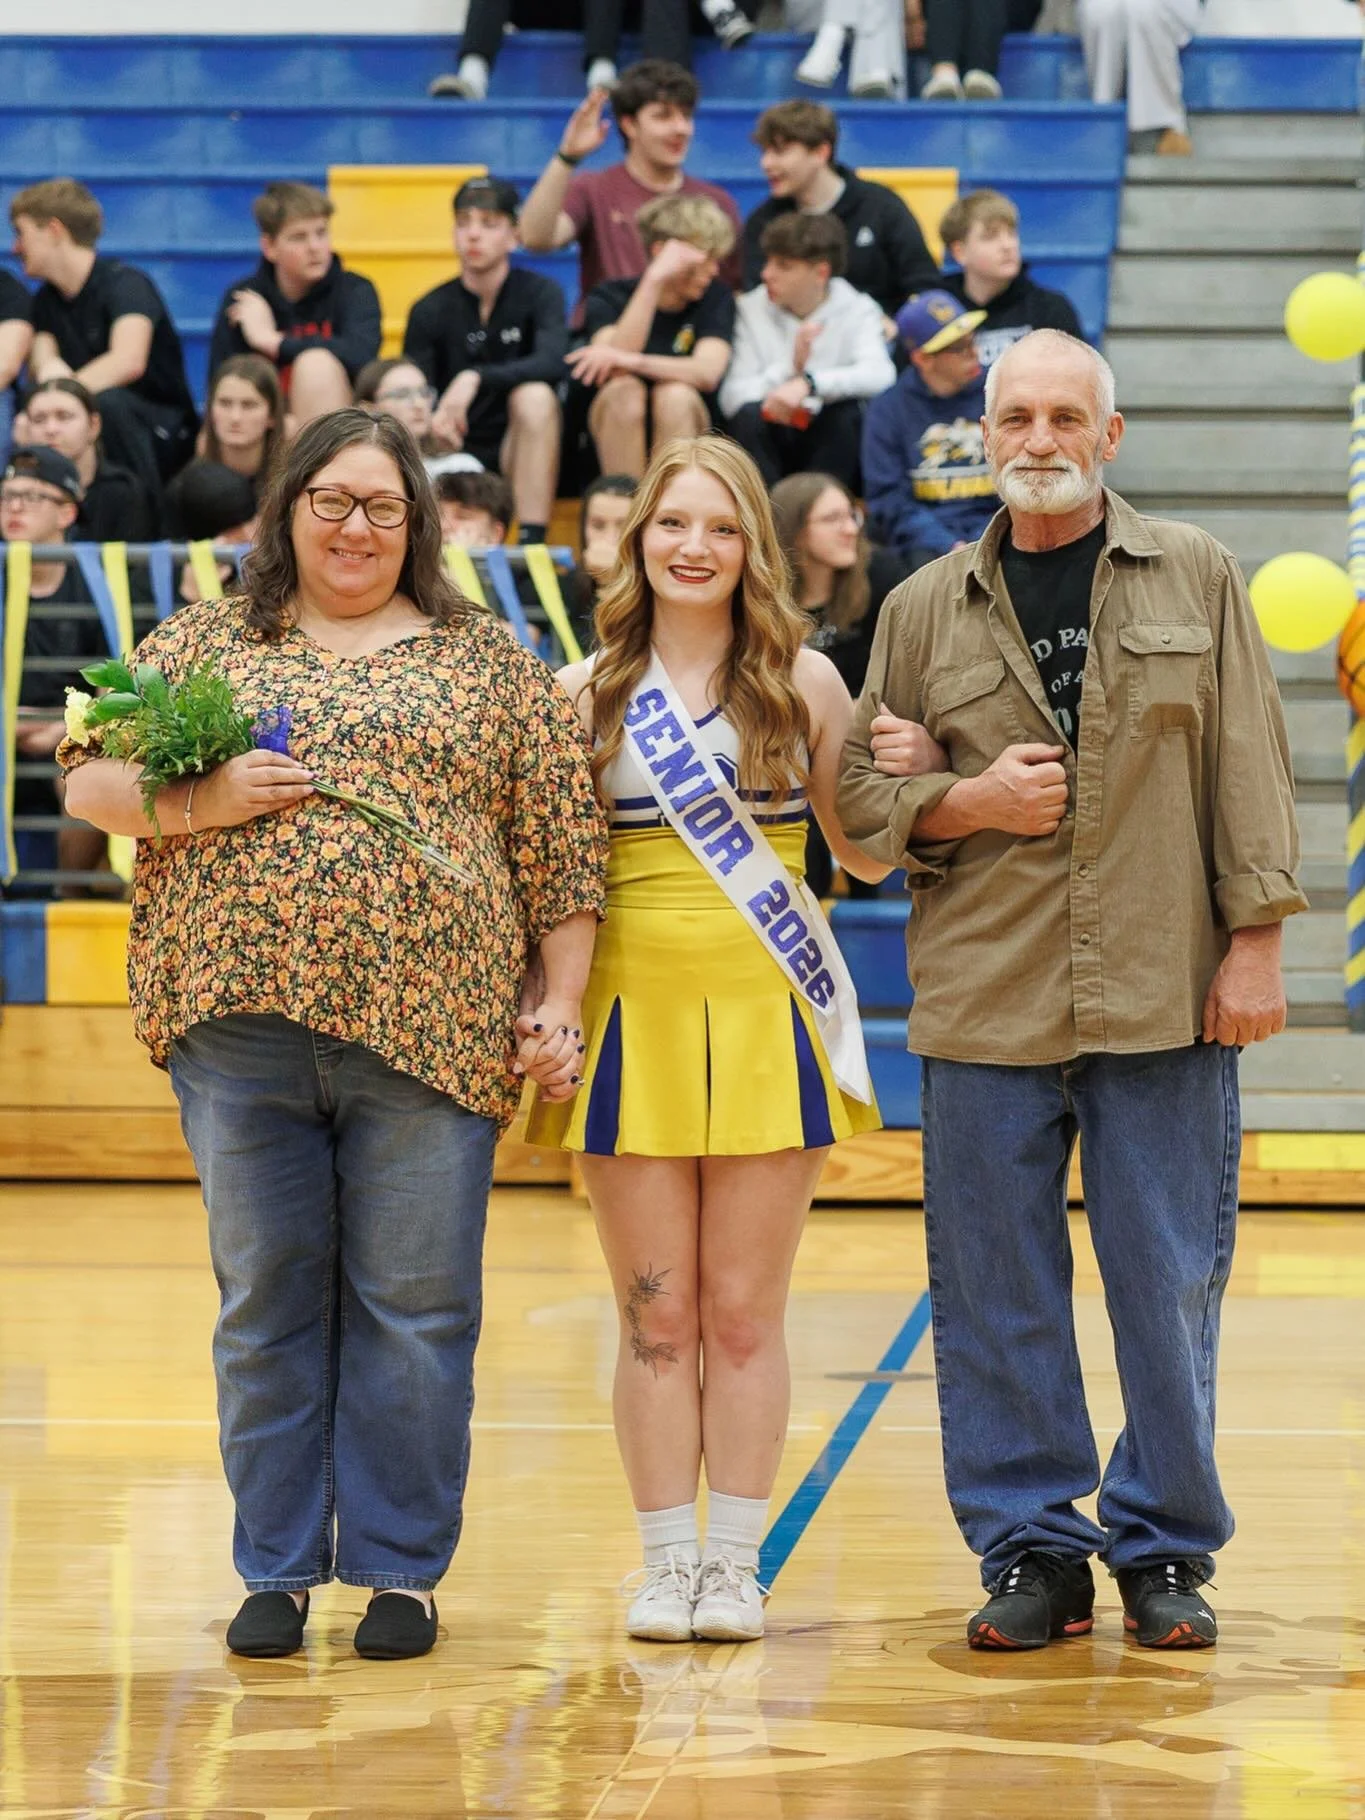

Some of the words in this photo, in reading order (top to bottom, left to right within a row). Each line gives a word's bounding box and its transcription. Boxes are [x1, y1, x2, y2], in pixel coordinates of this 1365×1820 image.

[1051, 671, 1072, 694] OF
[623, 688, 754, 876] SENIOR
[746, 879, 835, 1009] 2026
